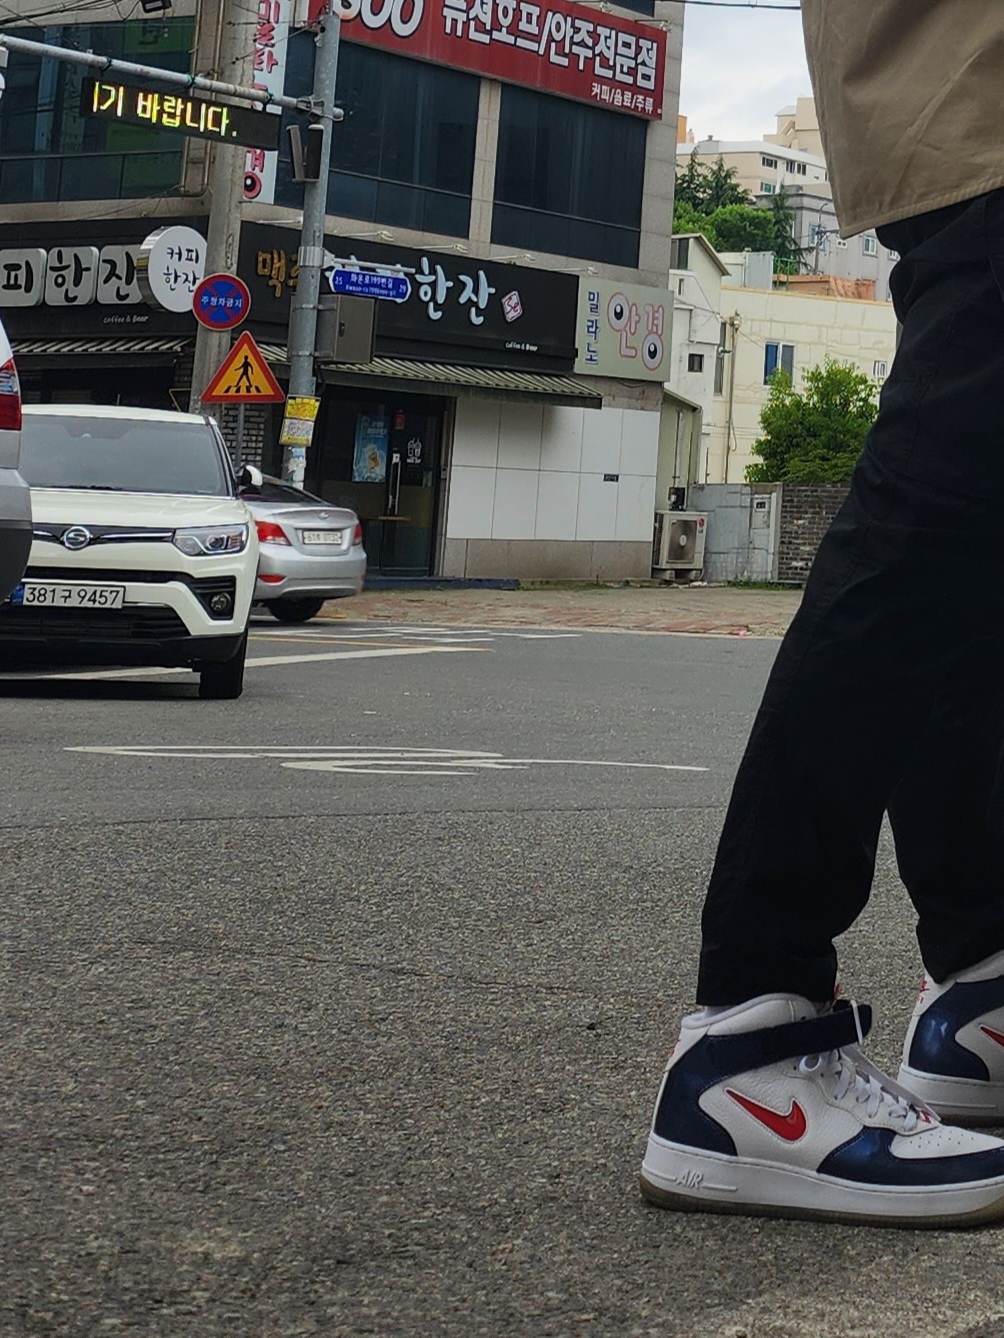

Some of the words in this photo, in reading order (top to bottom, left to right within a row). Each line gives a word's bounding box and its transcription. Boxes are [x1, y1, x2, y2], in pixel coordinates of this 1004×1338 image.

[136, 92, 238, 138] 바랍니다.
[166, 246, 200, 264] 커피
[163, 266, 200, 294] 한잔
[201, 295, 243, 309] 주정차금지
[585, 291, 600, 366] 밀라노
[606, 291, 664, 371] 안경
[25, 587, 72, 604] 381구
[76, 588, 120, 606] 9457
[675, 1169, 704, 1191] AIR
